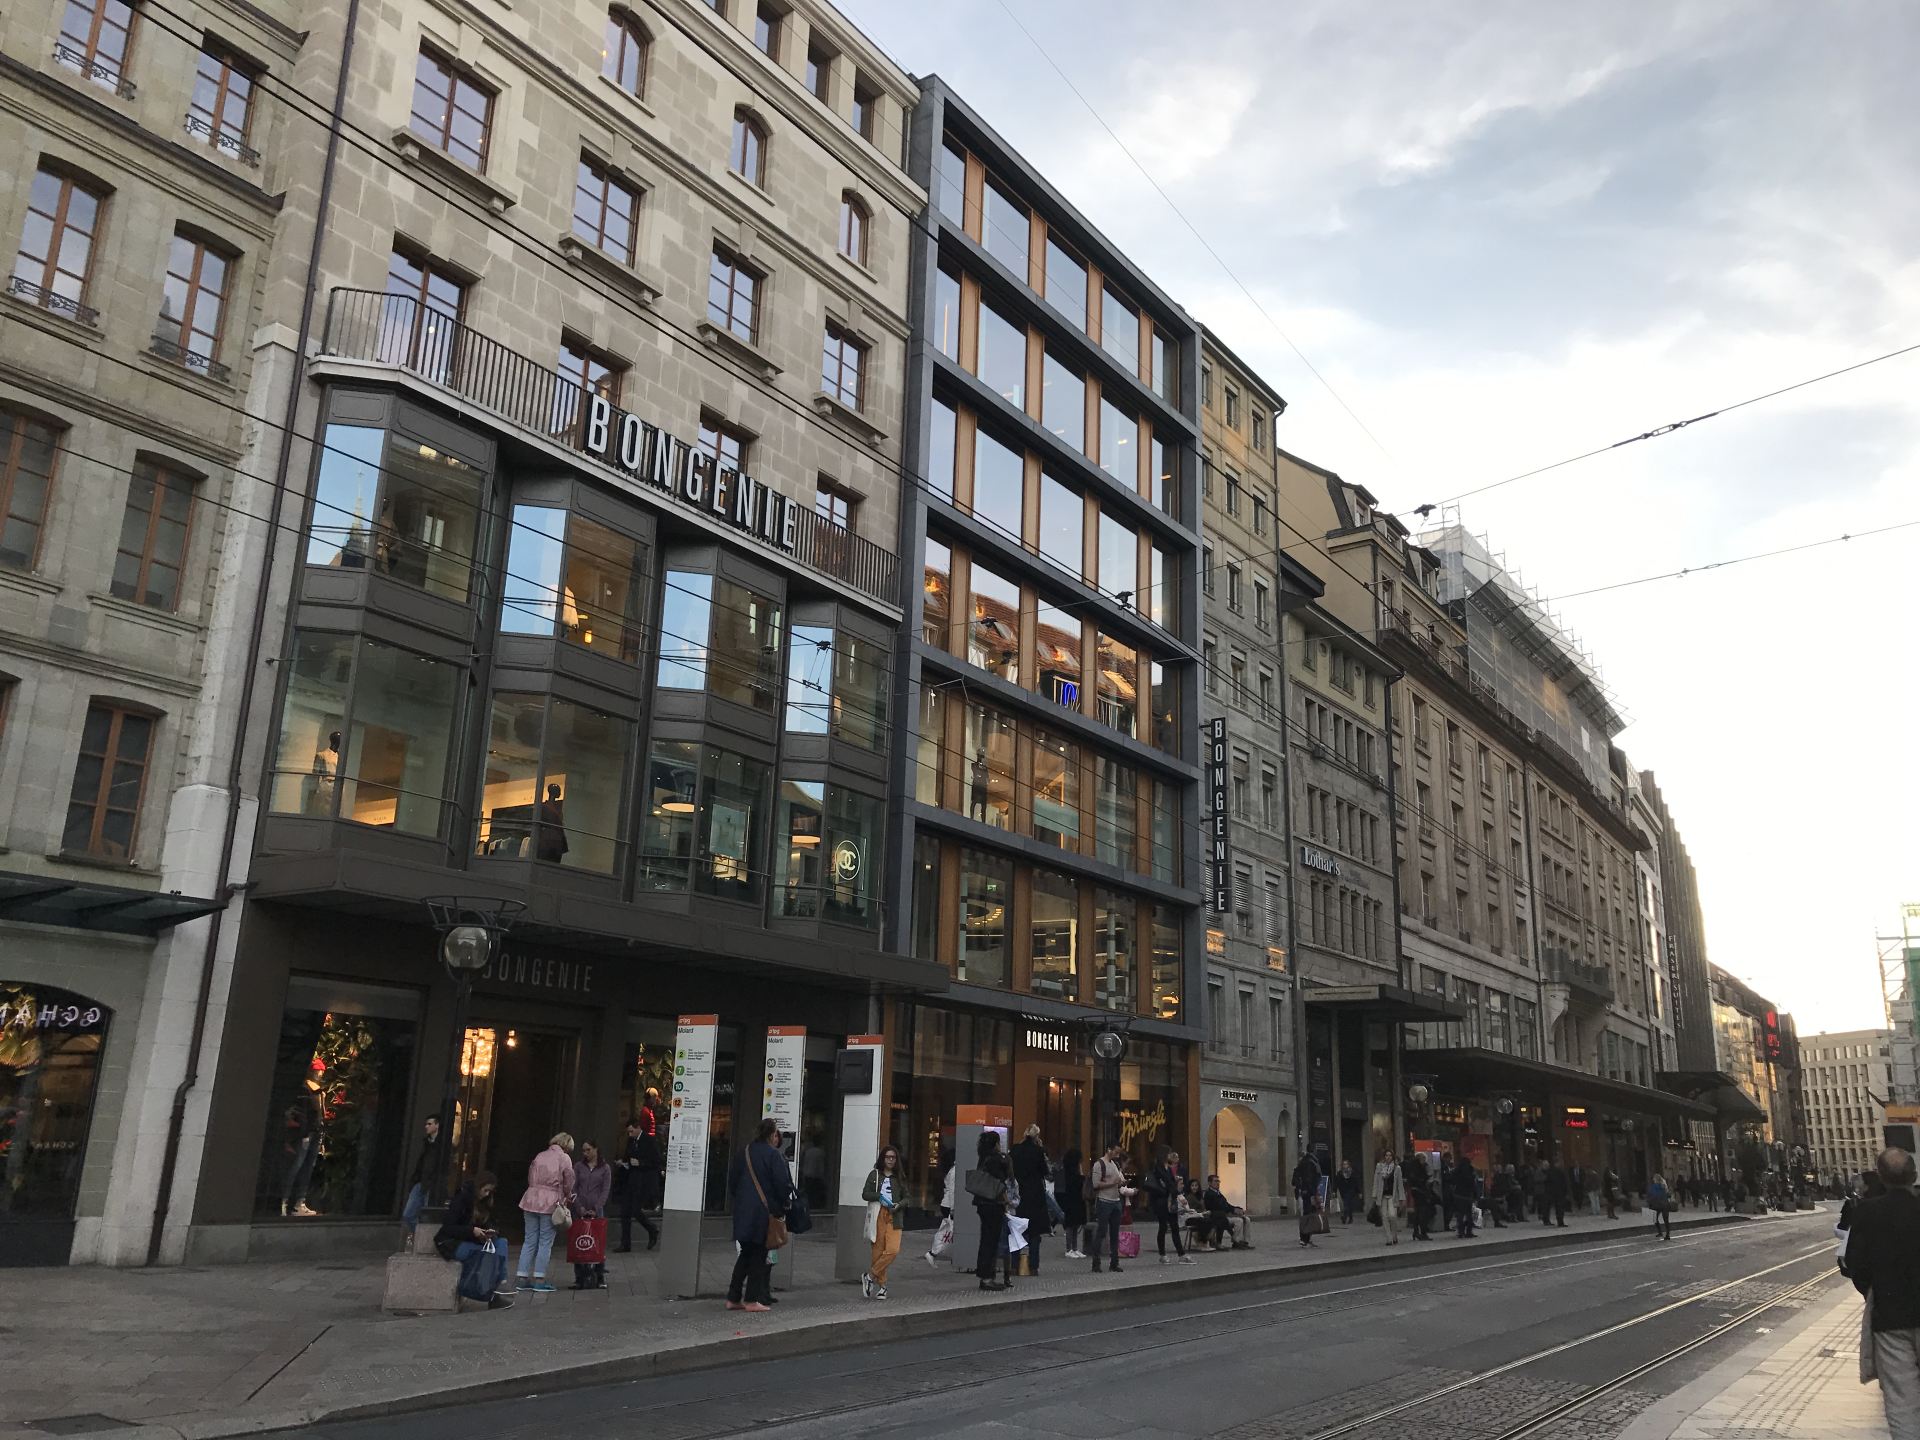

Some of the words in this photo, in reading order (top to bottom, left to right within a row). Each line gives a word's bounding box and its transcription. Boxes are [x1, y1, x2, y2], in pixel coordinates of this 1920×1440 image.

[587, 393, 799, 549] BONGENIE
[1214, 720, 1225, 911] BONGENIE
[1026, 1030, 1069, 1052] BONGENIE
[675, 1082, 682, 1090] 10
[673, 1099, 681, 1107] 12
